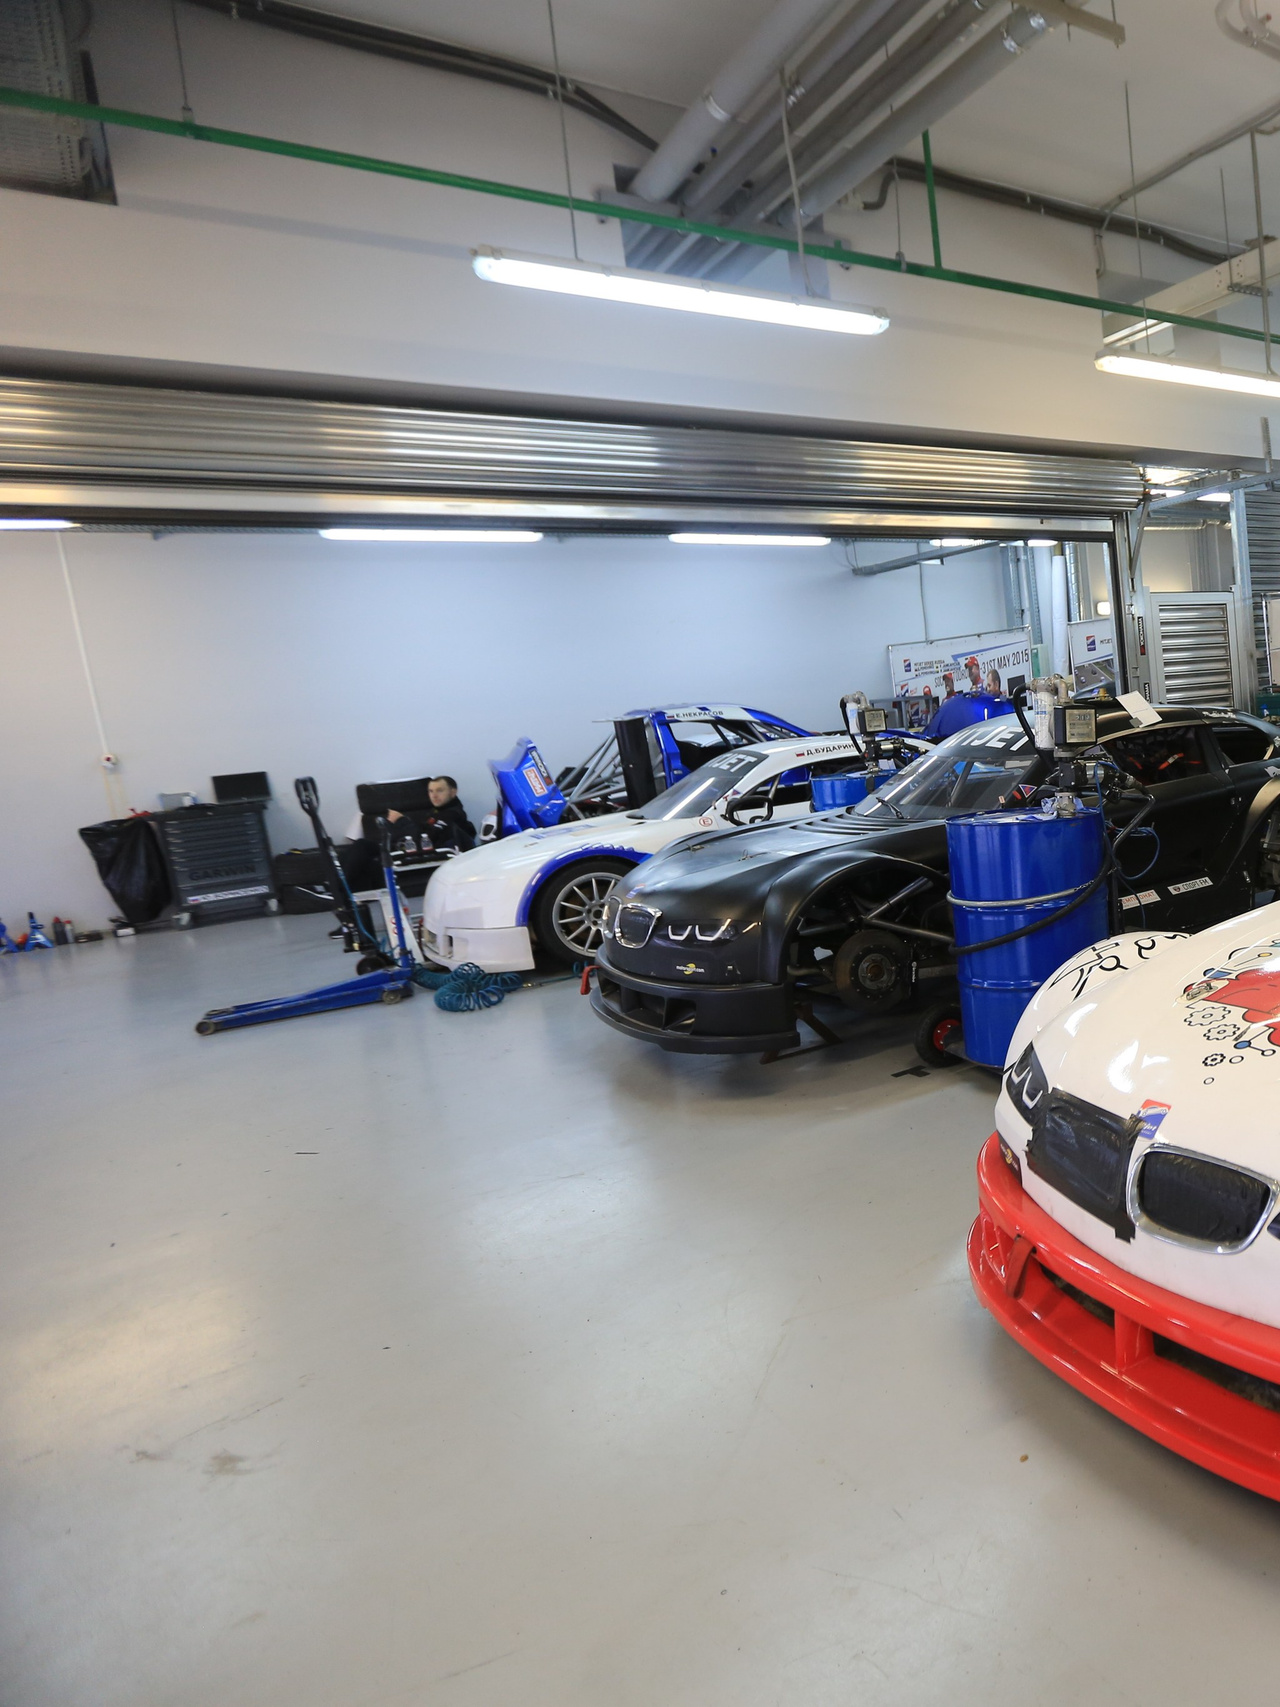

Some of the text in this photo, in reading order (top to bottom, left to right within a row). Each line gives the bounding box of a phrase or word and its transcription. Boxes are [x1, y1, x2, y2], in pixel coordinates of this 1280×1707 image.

[997, 654, 1011, 669] MAY
[1012, 648, 1030, 666] 2015
[1200, 878, 1209, 886] FM
